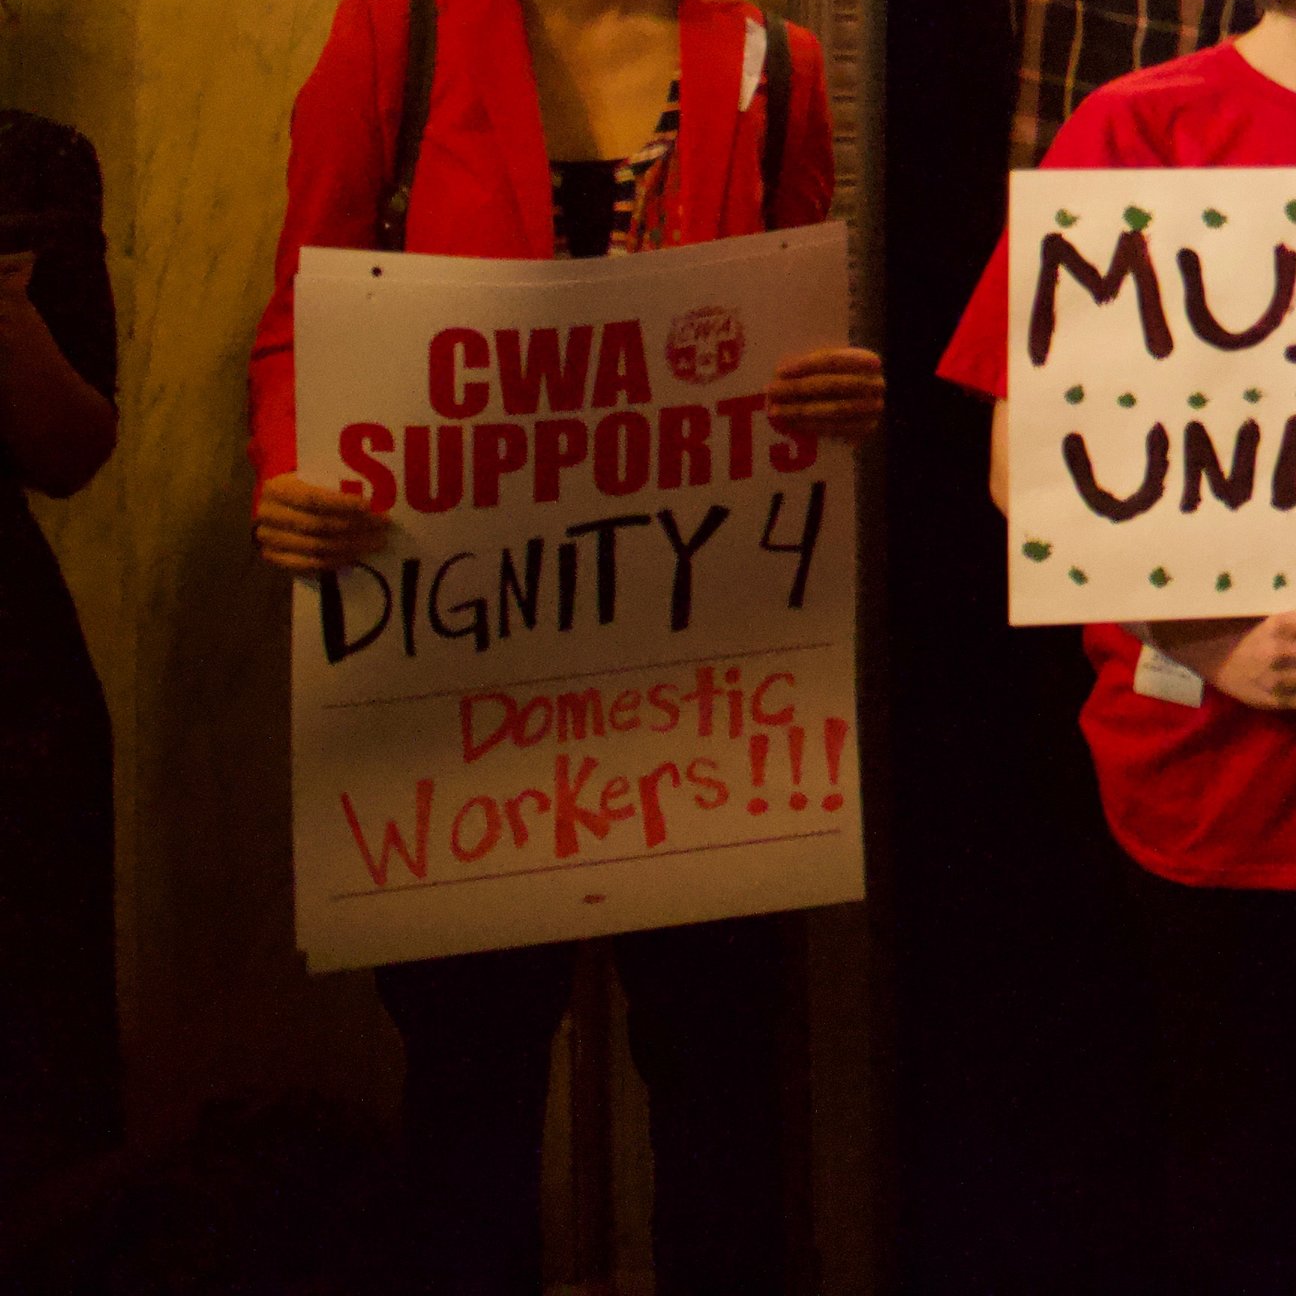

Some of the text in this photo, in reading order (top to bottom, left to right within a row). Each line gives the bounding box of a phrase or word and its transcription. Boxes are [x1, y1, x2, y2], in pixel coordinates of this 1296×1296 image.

[429, 318, 652, 419] CWA
[339, 393, 818, 514] SUPPORTS
[320, 481, 826, 664] DIGNITY 4
[460, 666, 796, 764] Domestic
